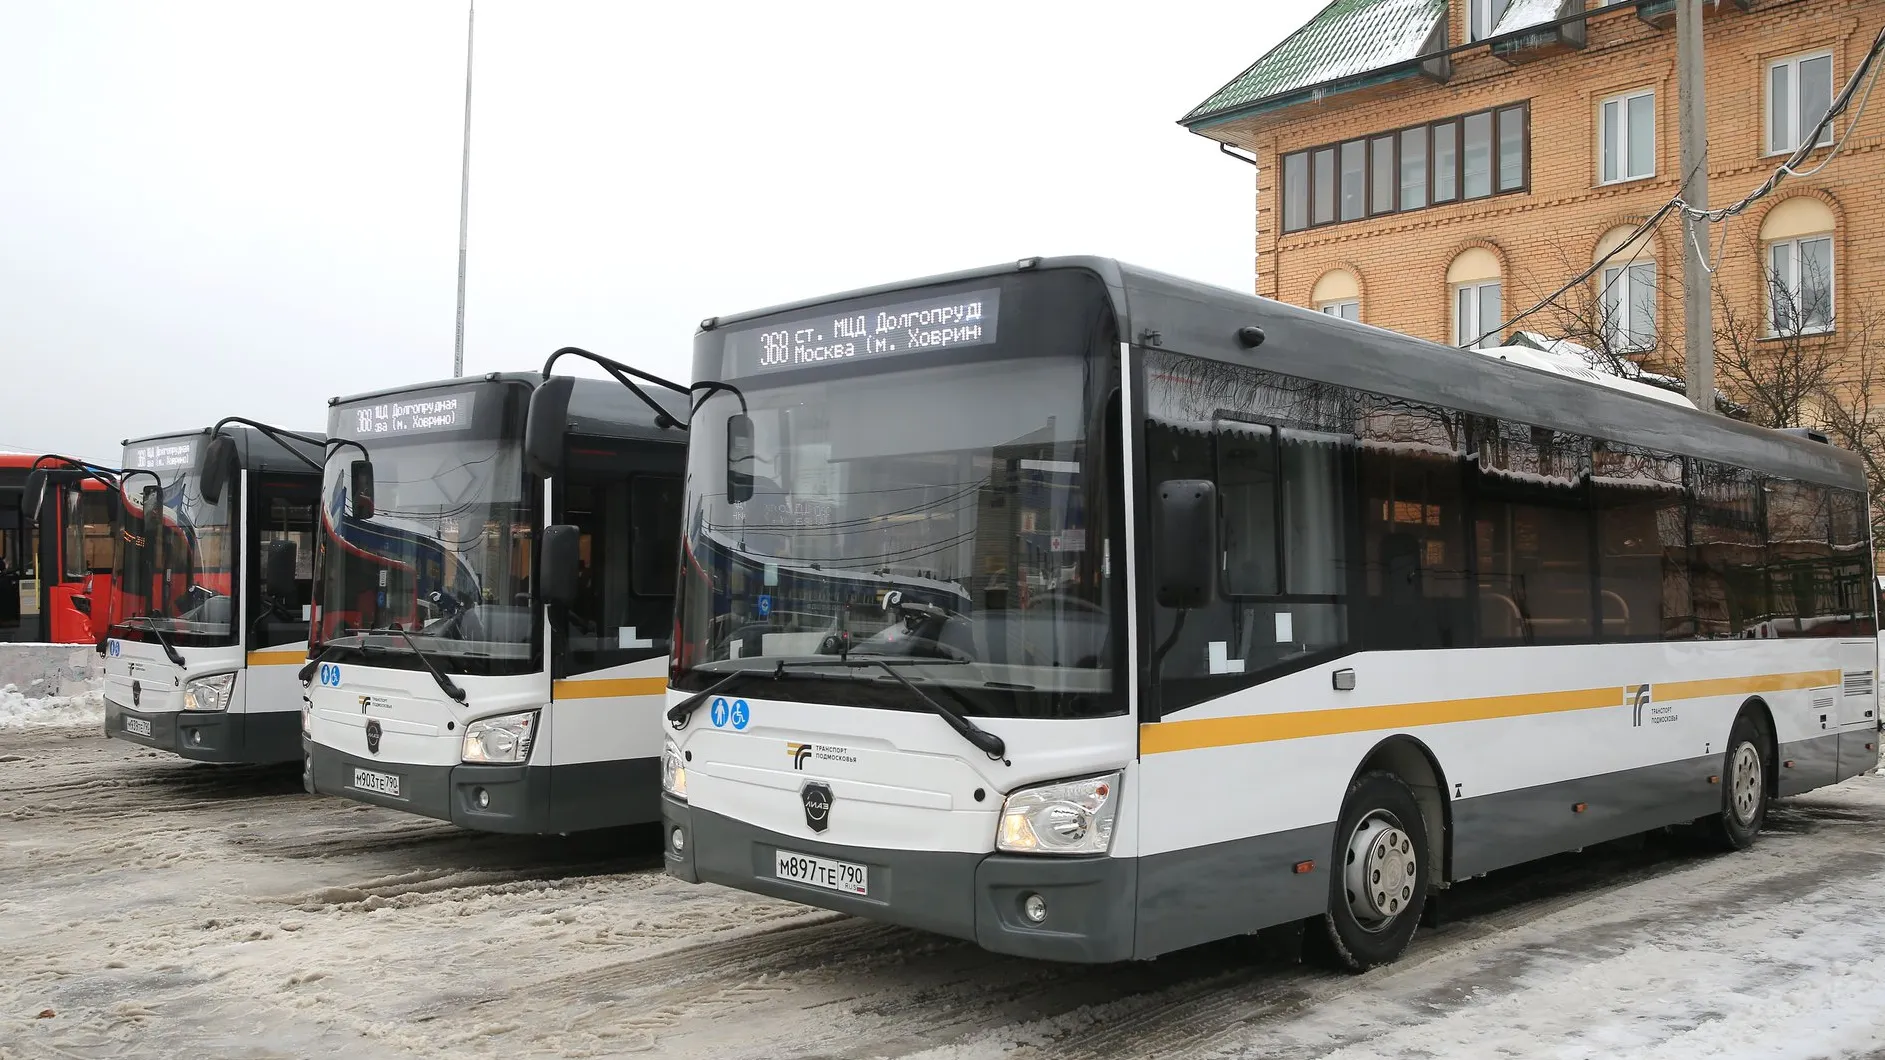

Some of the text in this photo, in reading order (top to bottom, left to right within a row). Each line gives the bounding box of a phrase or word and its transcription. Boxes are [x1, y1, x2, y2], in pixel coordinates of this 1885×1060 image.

[795, 302, 982, 344] ст. МЦД Долгопруд
[760, 330, 789, 366] 368
[794, 343, 855, 364] Москва
[392, 399, 458, 419] Долгопрудная
[815, 753, 857, 763] ПОДМОСКОВЬЯ
[816, 745, 847, 754] ТРАНСПОРТ
[780, 856, 863, 886] М897ТЕ 790
[844, 882, 857, 891] RUS
